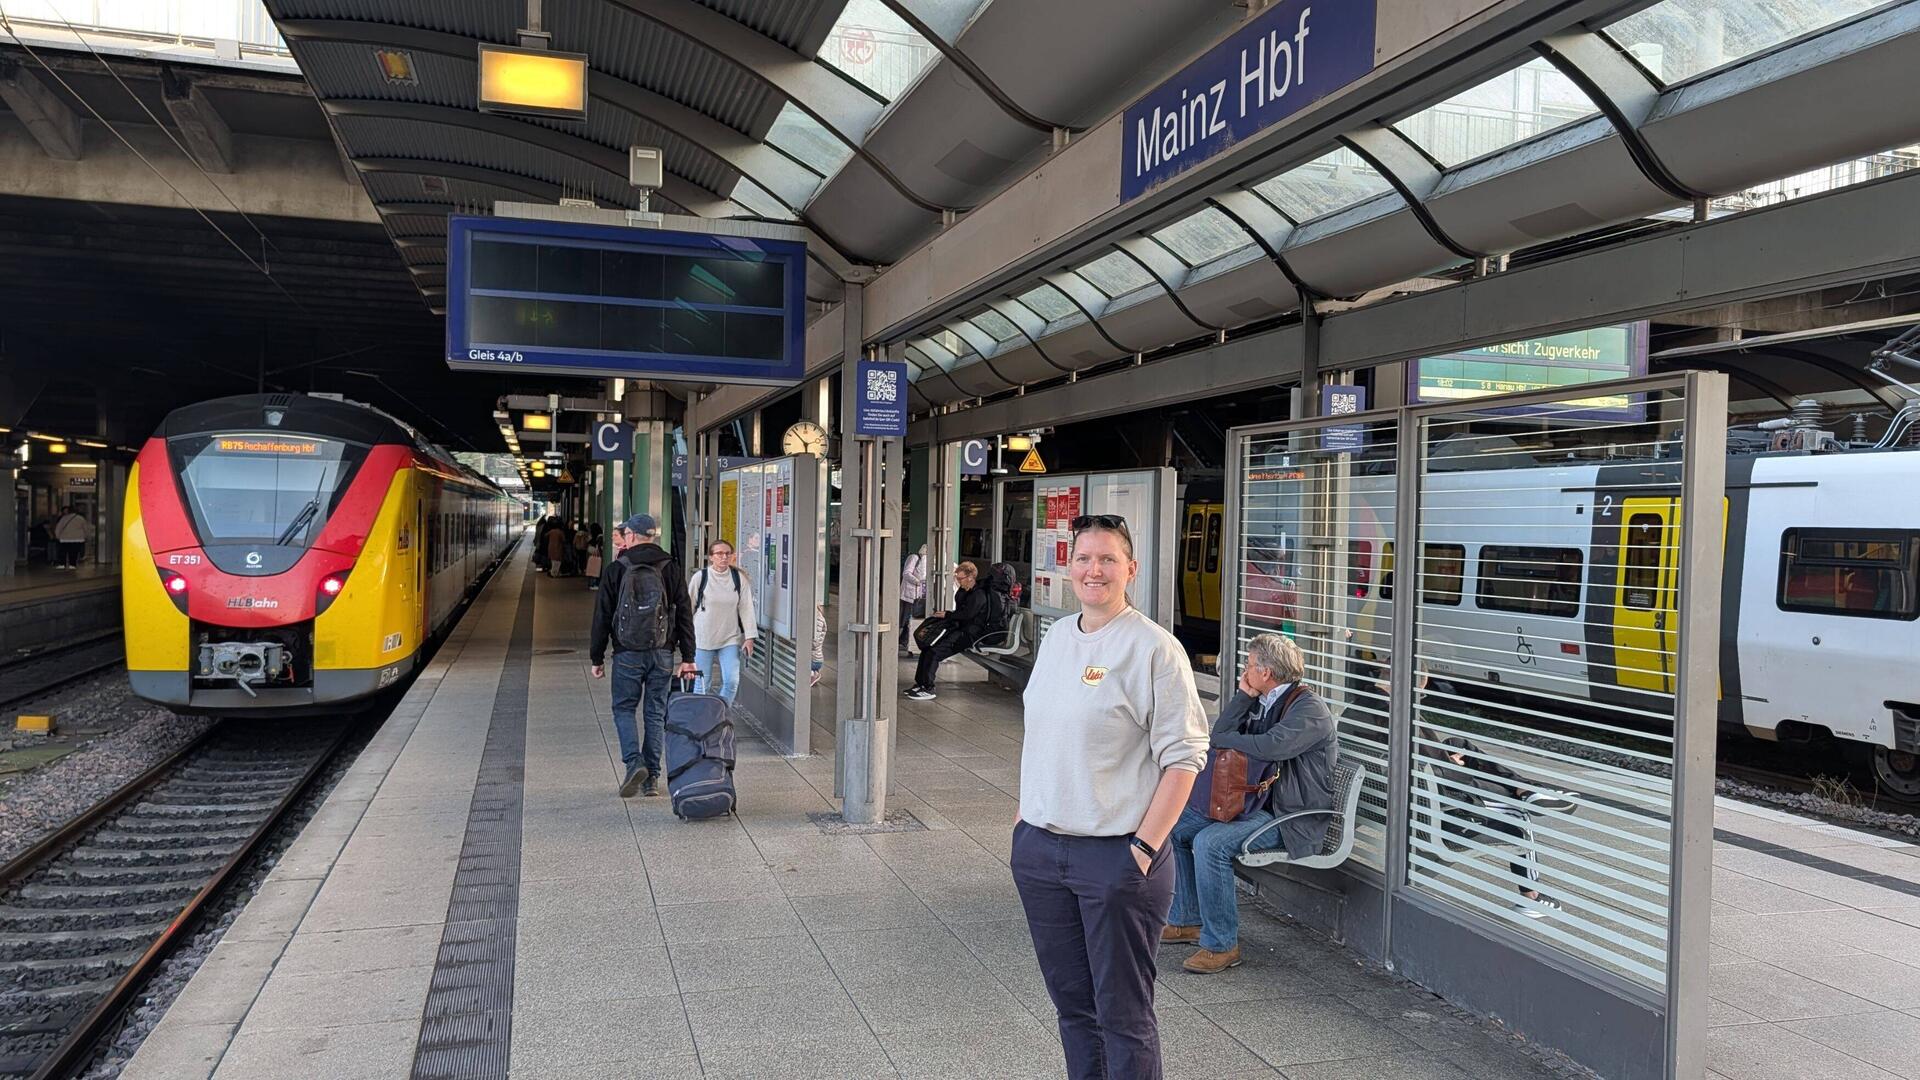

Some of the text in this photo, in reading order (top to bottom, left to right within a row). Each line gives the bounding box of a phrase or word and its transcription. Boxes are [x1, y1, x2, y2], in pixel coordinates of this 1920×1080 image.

[1136, 7, 1311, 177] Mainz Hbf
[469, 349, 523, 363] Gleis 4a/b
[1533, 342, 1601, 360] Zugverkehr
[221, 441, 316, 454] RB75 Aschaffenburg Hbf
[597, 423, 620, 453] C
[964, 439, 983, 467] C
[1602, 495, 1612, 516] 2
[170, 555, 201, 565] ET 351
